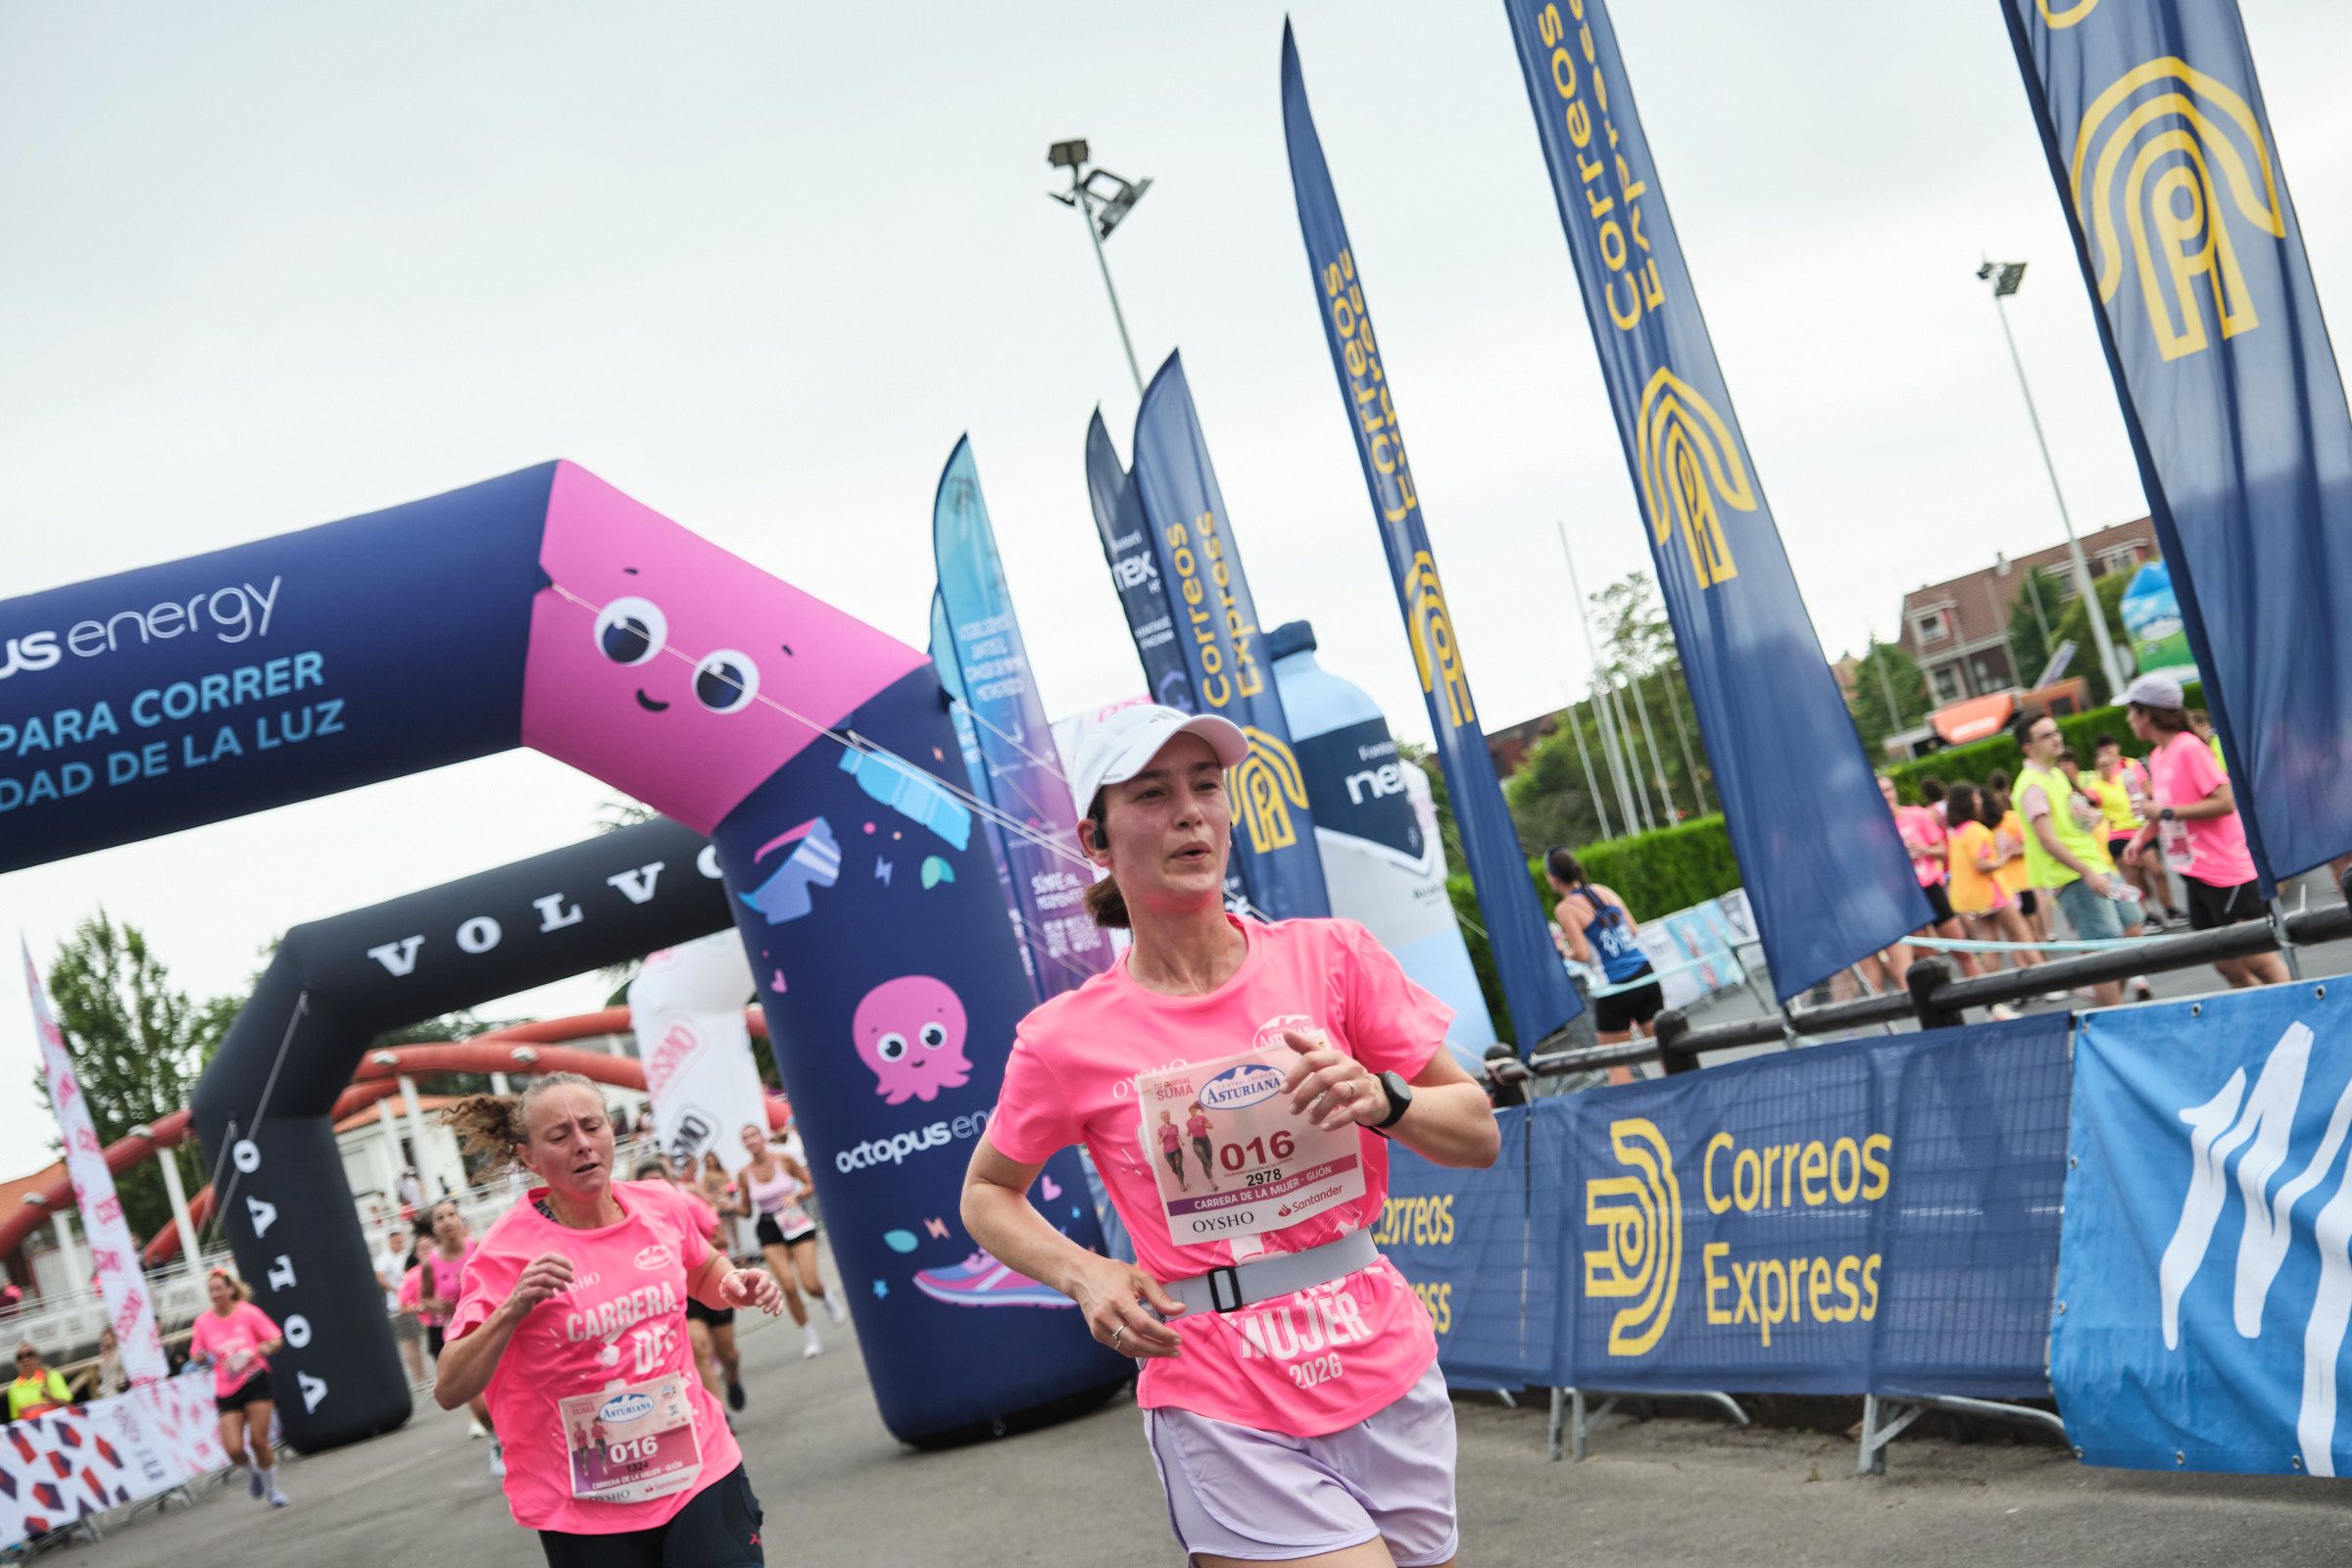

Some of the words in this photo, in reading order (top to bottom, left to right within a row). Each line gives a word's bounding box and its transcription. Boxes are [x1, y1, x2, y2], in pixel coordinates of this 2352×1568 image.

[1538, 3, 1642, 330] Correos
[68, 575, 281, 658] energy
[1166, 522, 1231, 708] Correos
[1196, 511, 1263, 698] Express
[130, 651, 324, 727] CORRER
[108, 742, 169, 785] DE
[183, 726, 243, 767] LA
[256, 698, 345, 751] LUZ
[1346, 762, 1413, 805] ne
[1156, 1084, 1195, 1102] SUMA
[1206, 1077, 1281, 1104] ASTURIANA
[836, 1121, 953, 1173] octopus
[1220, 1130, 1296, 1171] 016
[1195, 1194, 1238, 1210] CARRERA
[1241, 1190, 1254, 1201] DE
[1254, 1187, 1268, 1199] LA
[1270, 1178, 1299, 1196] MUJER
[1306, 1164, 1332, 1183] GIJÓN
[1246, 1168, 1282, 1187] 2978
[1293, 1184, 1344, 1213] Santander
[1703, 1132, 1892, 1215] Correos
[1193, 1211, 1254, 1233] OYSHO
[232, 1139, 329, 1414] VOLVO
[564, 1271, 601, 1294] SHO
[1703, 1242, 1883, 1348] Express
[565, 1280, 679, 1344] CARRERA
[1237, 1291, 1373, 1360] MUJER
[1289, 1352, 1344, 1390] 2026
[610, 1435, 659, 1464] 016
